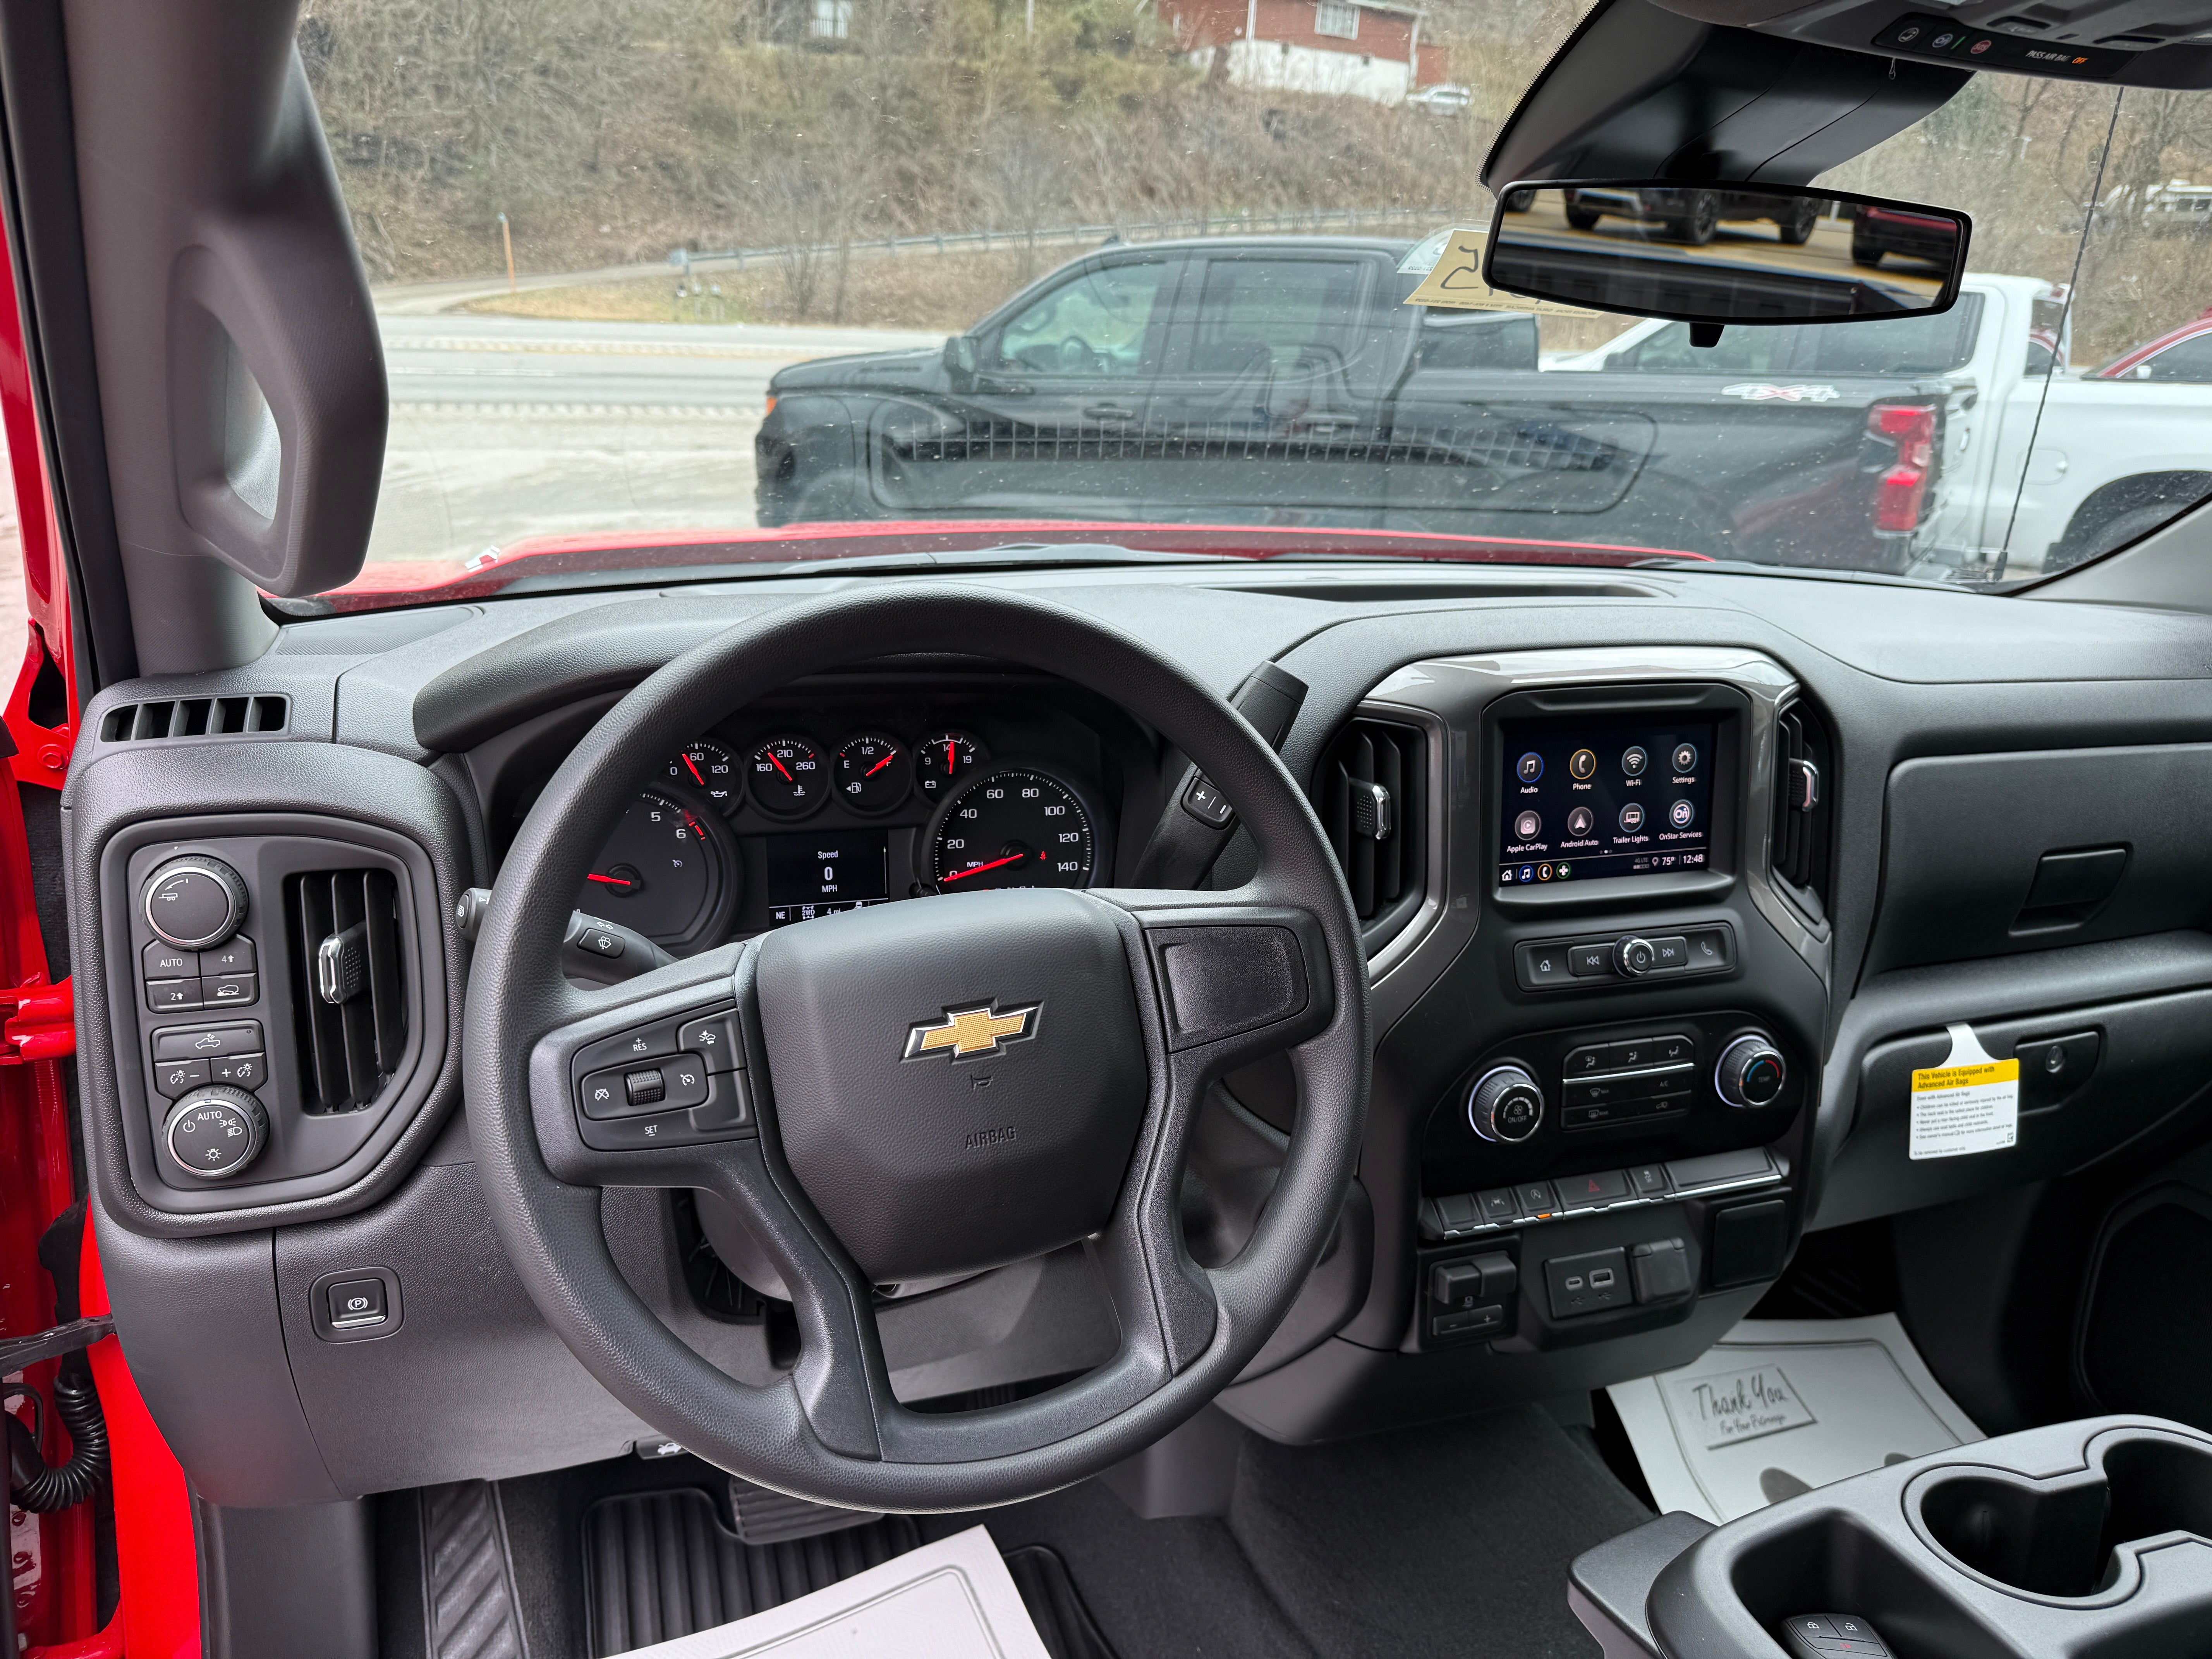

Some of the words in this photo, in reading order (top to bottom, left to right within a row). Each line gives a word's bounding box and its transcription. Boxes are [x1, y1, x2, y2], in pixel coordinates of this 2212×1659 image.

[2026, 50, 2044, 58] PASS
[690, 753, 704, 761] 60
[777, 750, 793, 758] 210
[756, 763, 772, 771] 160
[796, 762, 815, 770] 260
[844, 760, 850, 768] E
[670, 767, 678, 775] 0
[986, 789, 1003, 799] 60
[1022, 788, 1039, 798] 80
[960, 809, 977, 819] 40
[1044, 806, 1065, 816] 100
[651, 812, 661, 822] 5
[676, 829, 686, 839] 6
[1058, 833, 1079, 842] 120
[1659, 832, 1678, 840] OnStar
[947, 839, 964, 849] 20
[1560, 840, 1583, 848] Android
[1631, 835, 1649, 844] Lights
[1506, 845, 1524, 854] Apple
[1525, 843, 1548, 851] CarPlay
[817, 850, 838, 860] Speed
[1683, 854, 1704, 864] 12:48
[1057, 862, 1078, 871] 140
[824, 866, 833, 881] 0
[822, 884, 837, 893] MPH
[160, 958, 183, 967] AUTO
[633, 1043, 647, 1052] RES
[1958, 1068, 1983, 1077] Equipped
[1918, 1080, 1945, 1089] Advanced
[1955, 1078, 1969, 1086] Bags
[197, 1110, 223, 1121] AUTO
[1508, 1115, 1527, 1123] ON/OFF
[645, 1125, 658, 1135] SET
[965, 1126, 1016, 1150] AIRBAG
[1692, 1378, 1752, 1421] Thank
[1751, 1372, 1789, 1409] You
